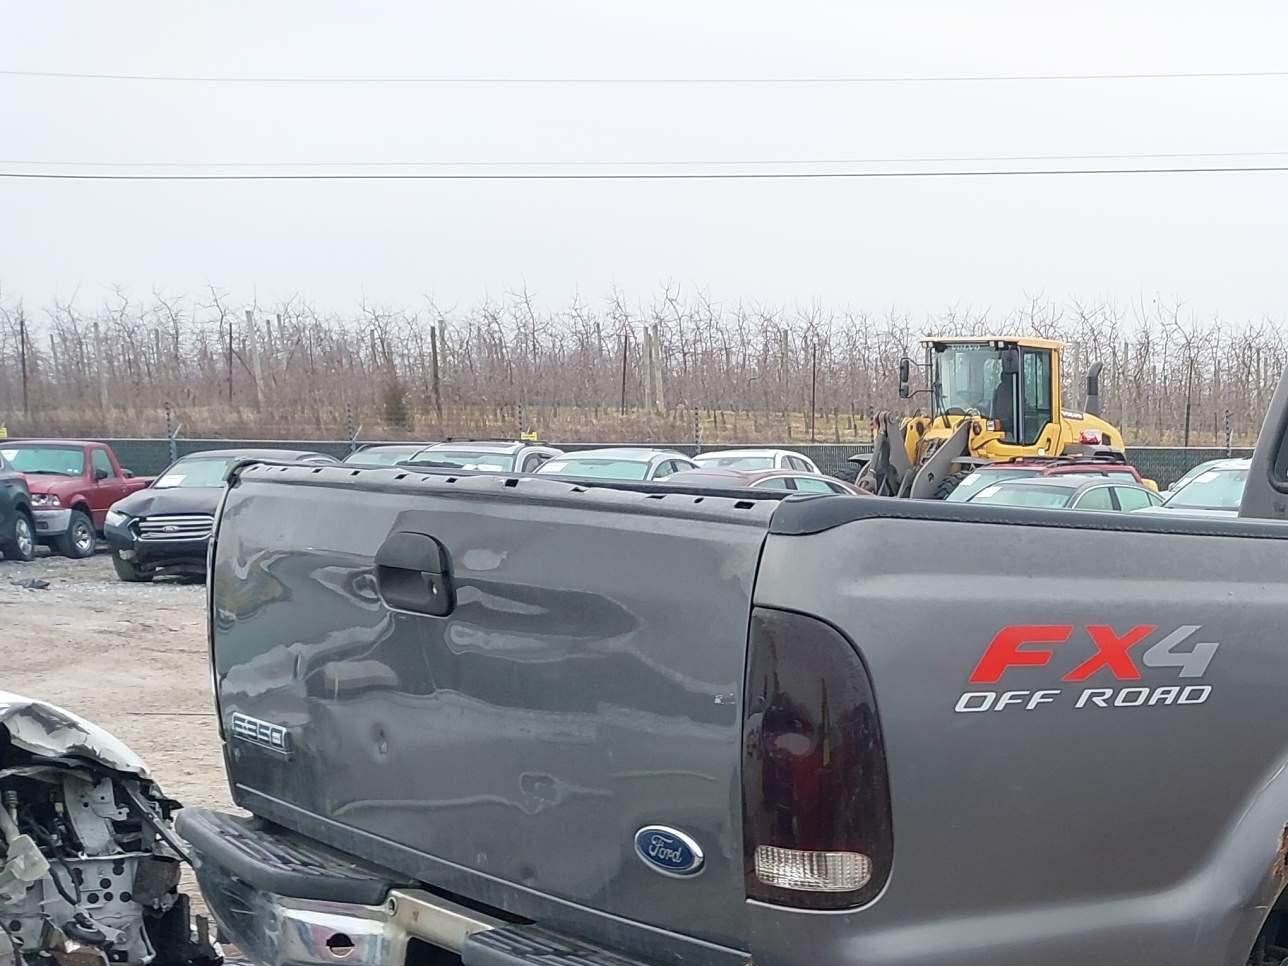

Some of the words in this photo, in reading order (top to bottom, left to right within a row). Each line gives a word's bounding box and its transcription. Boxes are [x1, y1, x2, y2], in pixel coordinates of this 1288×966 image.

[968, 624, 1221, 685] FX4
[954, 689, 1062, 713] OFF
[1074, 684, 1213, 709] ROAD
[648, 834, 683, 863] Ford
